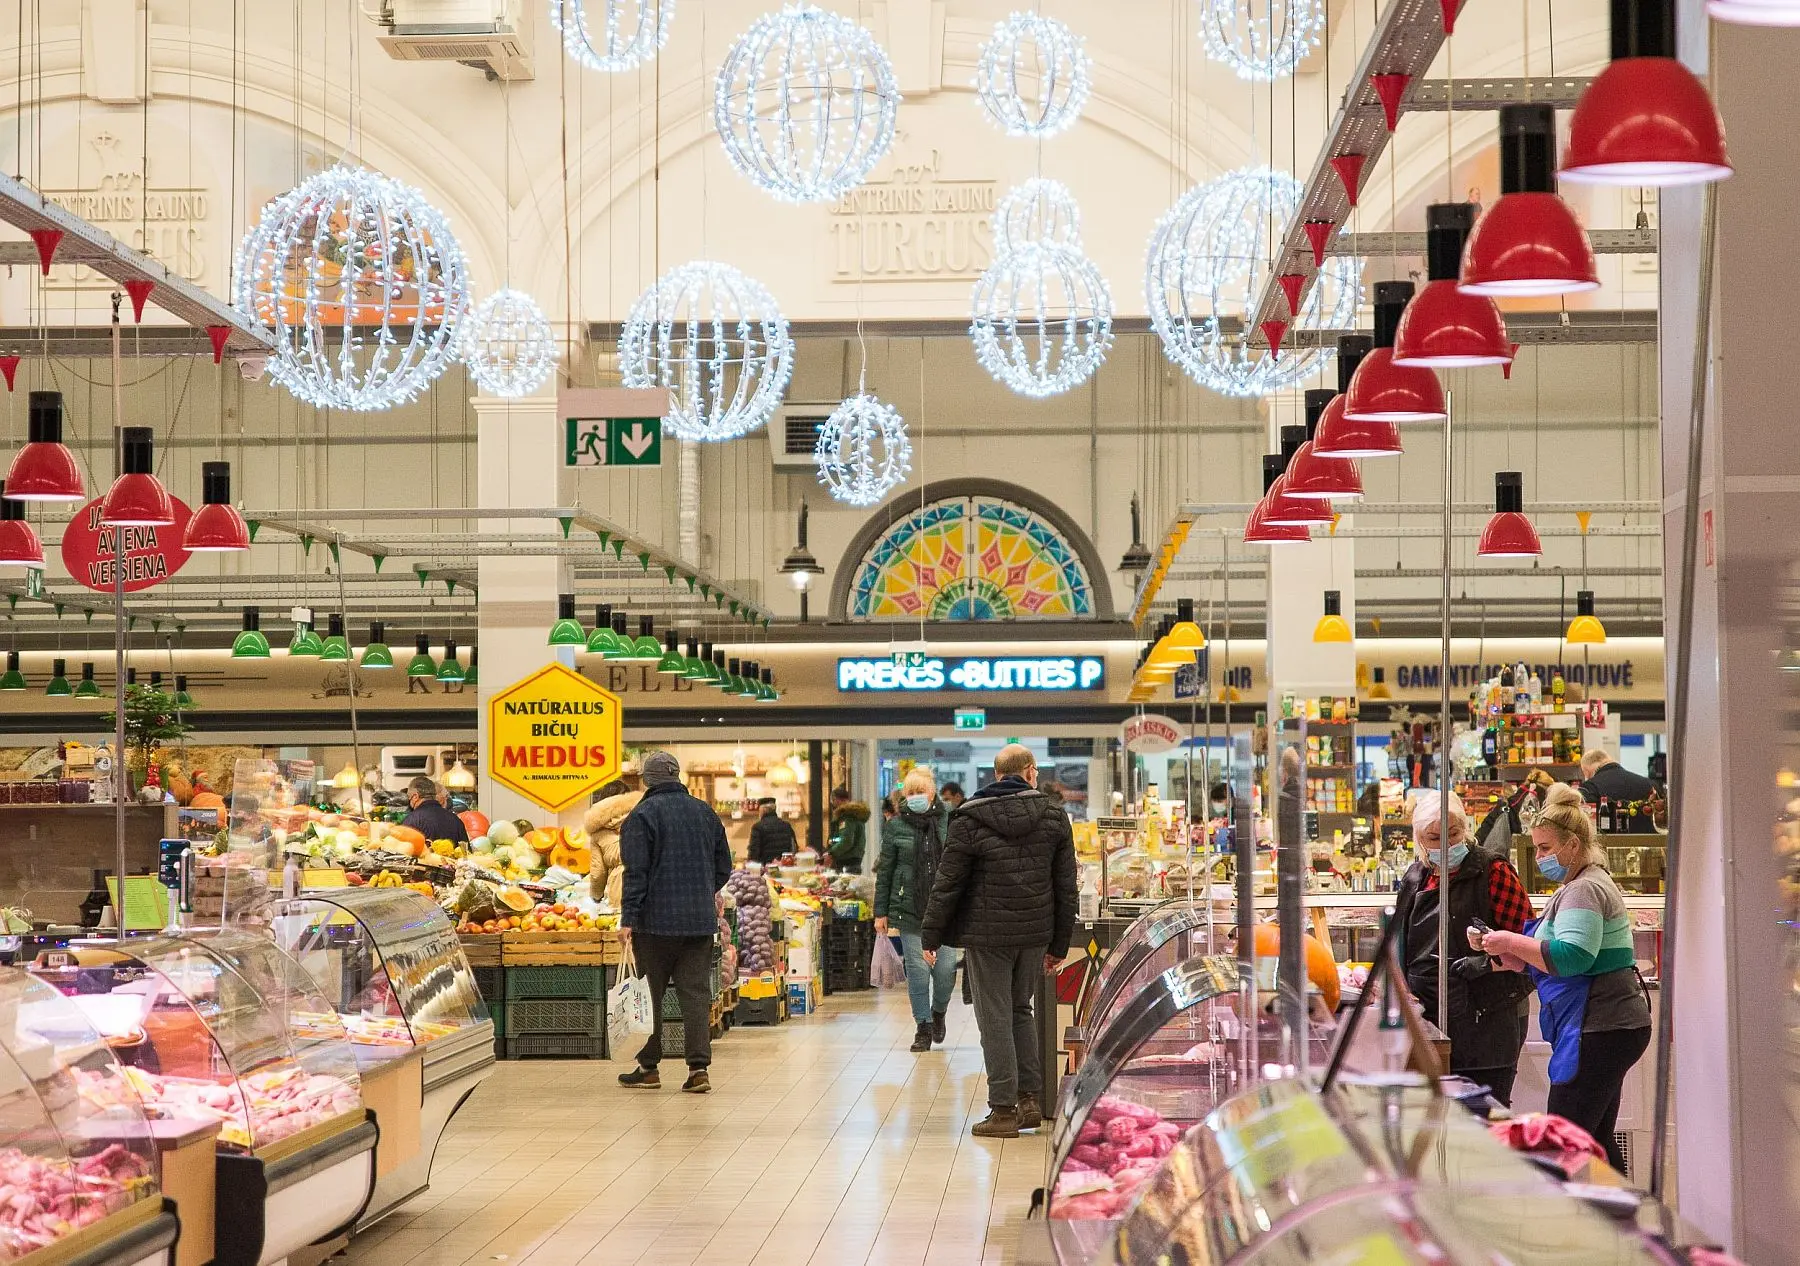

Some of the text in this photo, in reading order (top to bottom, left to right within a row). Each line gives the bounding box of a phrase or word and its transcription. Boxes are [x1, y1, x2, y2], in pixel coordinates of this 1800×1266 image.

[97, 524, 157, 556] AVENA
[504, 698, 604, 715] NATŪRALUS
[531, 719, 578, 739] BIČIŲ
[501, 745, 606, 768] MEDUS
